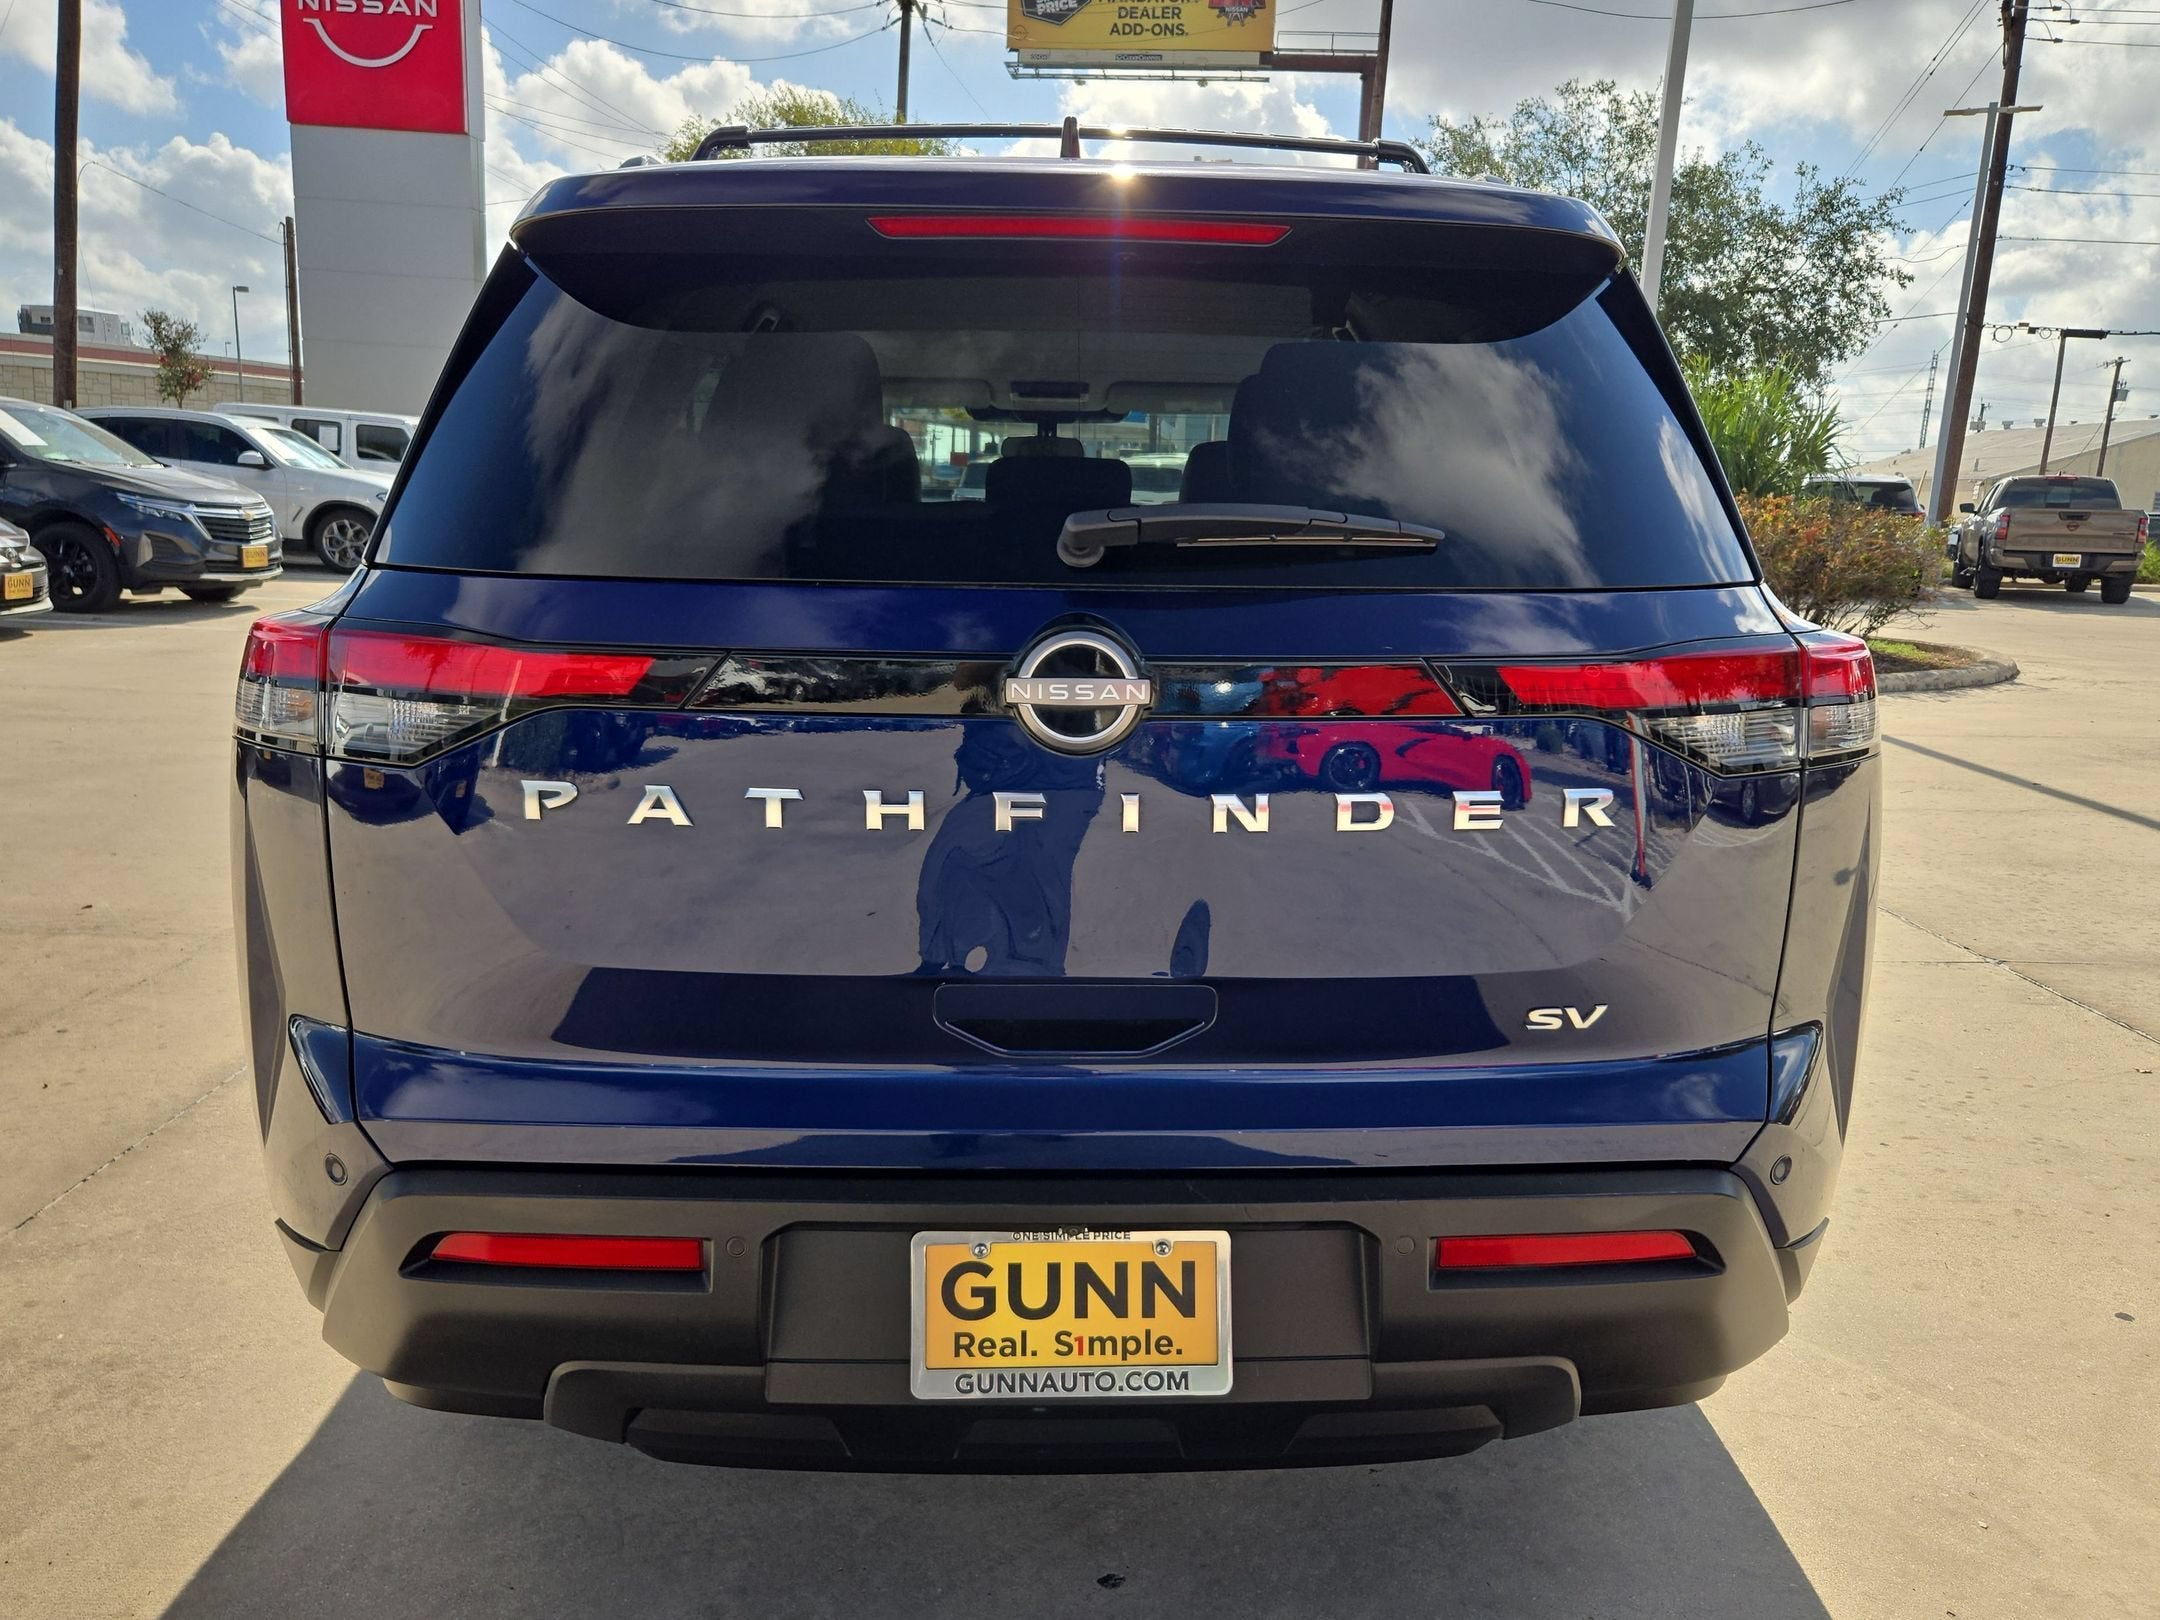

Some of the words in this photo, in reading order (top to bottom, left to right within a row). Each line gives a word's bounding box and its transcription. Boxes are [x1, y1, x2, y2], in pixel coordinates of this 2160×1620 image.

[297, 0, 437, 17] NISSAN
[1118, 6, 1182, 19] DEALER
[1109, 23, 1189, 36] ADD-ONS.
[8, 576, 30, 588] GUNN
[1010, 682, 1146, 701] NISSAN
[520, 779, 1616, 833] PATHFINDER
[1525, 1004, 1609, 1030] SV
[1013, 1231, 1039, 1240] ONE
[1093, 1231, 1131, 1240] PRICE
[941, 1260, 1196, 1321] GUNN
[954, 1329, 1038, 1357] Real.
[954, 1370, 1189, 1394] GUNNAUTO.COM
